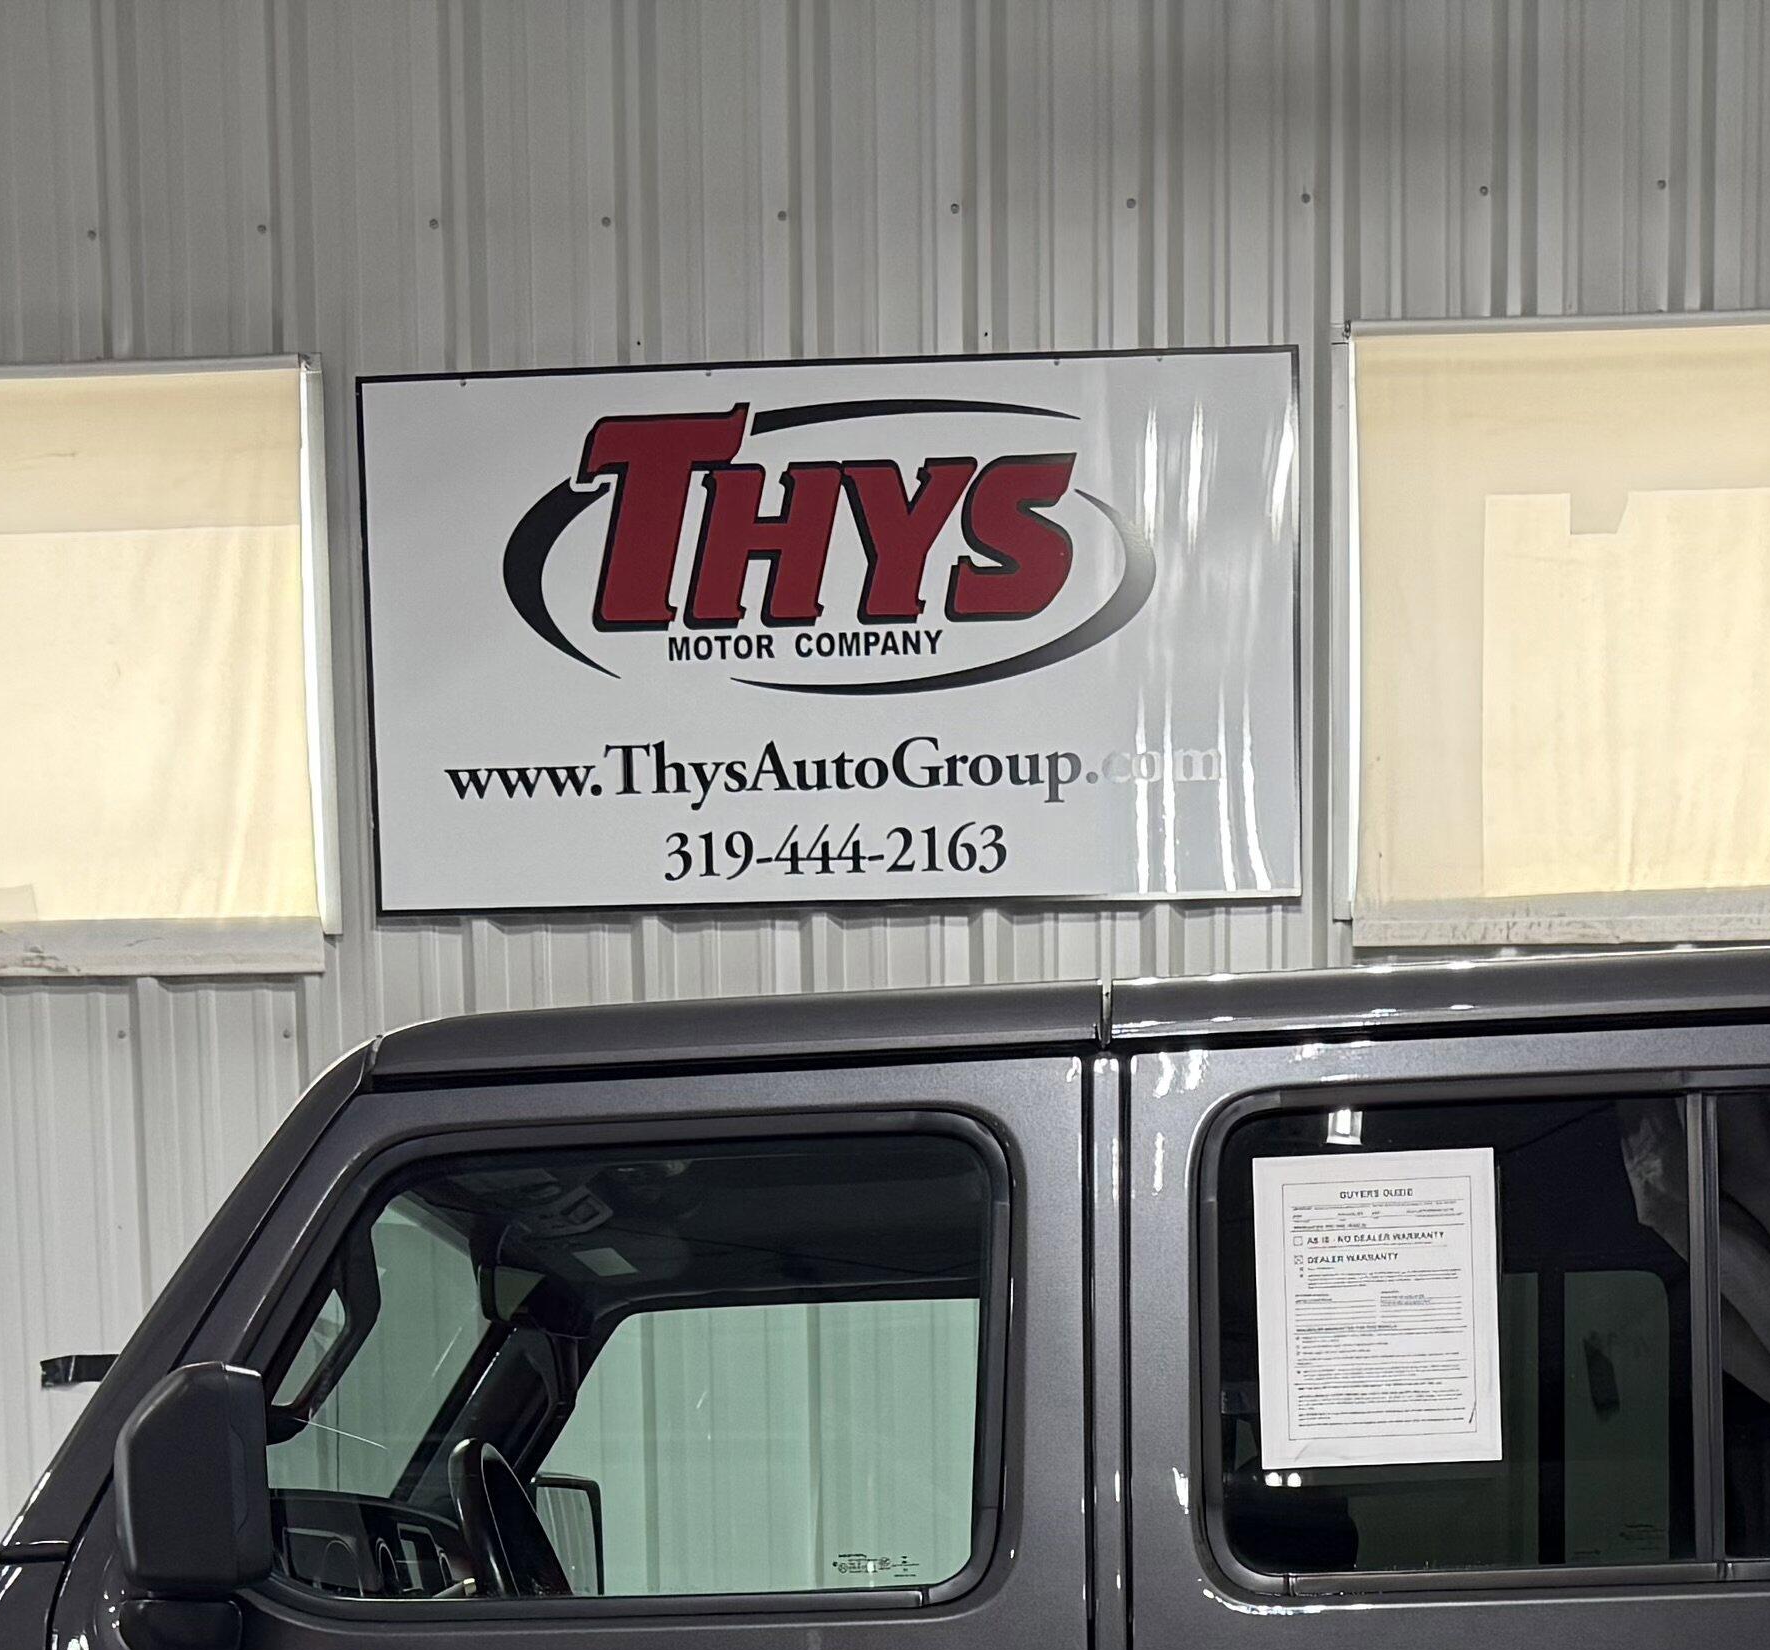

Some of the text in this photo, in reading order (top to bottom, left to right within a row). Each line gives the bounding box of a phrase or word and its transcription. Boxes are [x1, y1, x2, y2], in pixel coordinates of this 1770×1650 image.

[573, 403, 1077, 632] THYS
[668, 629, 943, 661] MOTOR COMPANY
[444, 736, 1222, 811] www.ThysAutoGroup.com
[664, 821, 1008, 881] 319-444-2163
[1307, 1253, 1399, 1265] DEALER WARRANTY
[1354, 1232, 1390, 1243] DEALER
[1392, 1230, 1445, 1242] WARRANTY
